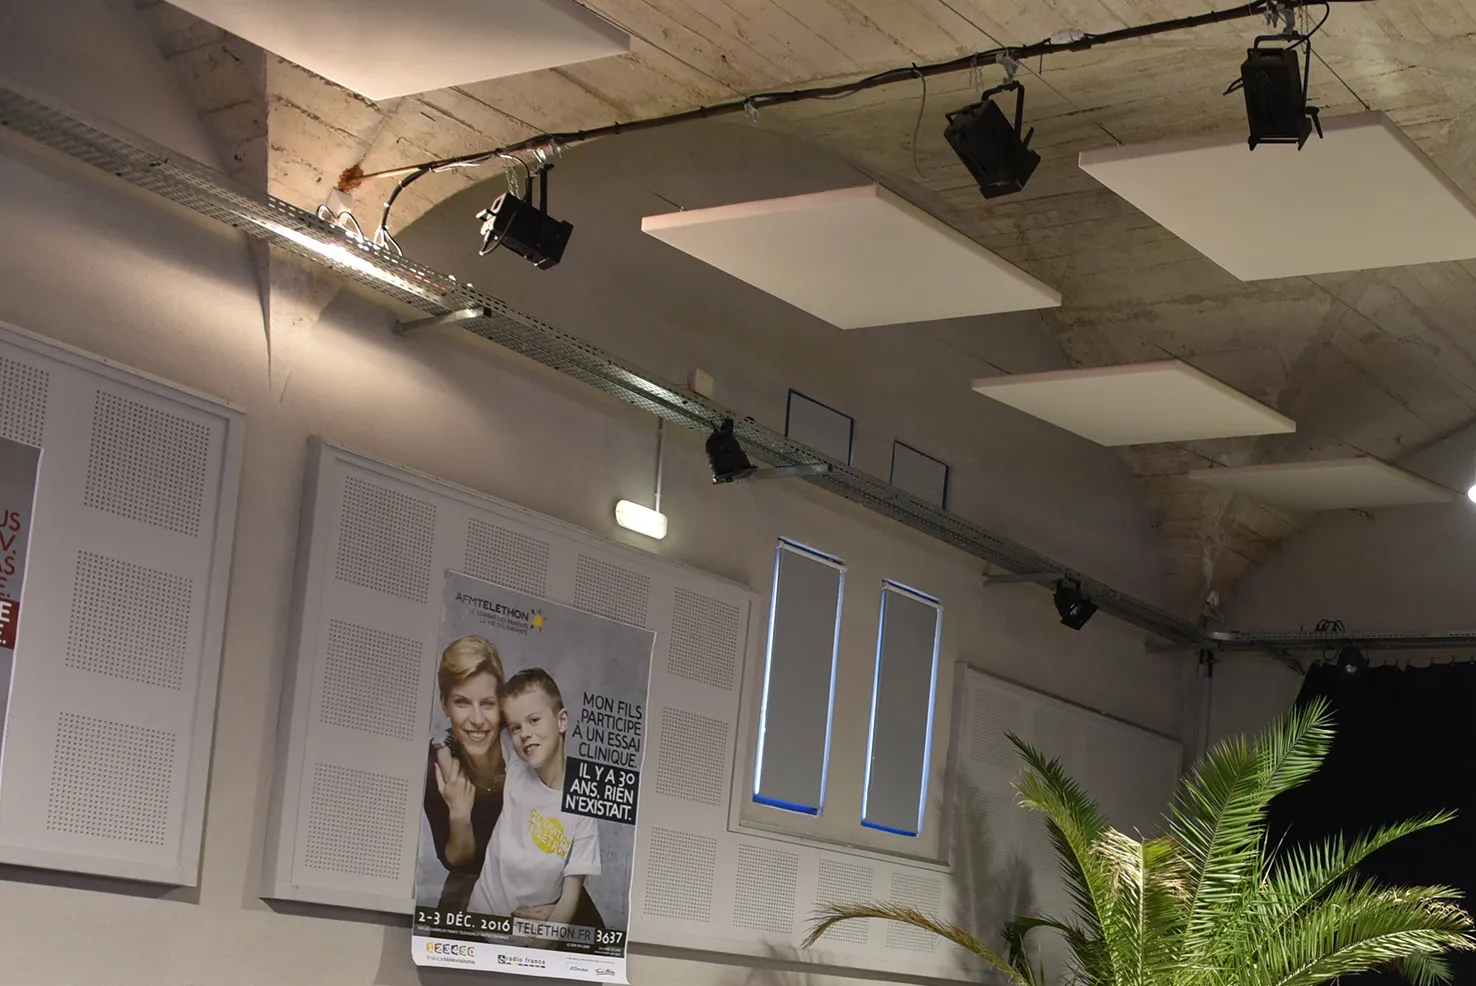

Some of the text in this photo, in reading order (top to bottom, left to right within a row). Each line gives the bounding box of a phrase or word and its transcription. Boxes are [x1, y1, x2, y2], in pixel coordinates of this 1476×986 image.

[583, 691, 643, 720] MON FILS
[581, 708, 642, 736] PARTICIPE
[572, 719, 641, 752] À UN ESSAI
[578, 741, 638, 769] CLINIQUE.
[579, 762, 636, 787] IL Y A 30
[604, 784, 634, 804] RIEN
[565, 794, 632, 821] N'EXISTAIT.
[418, 911, 511, 932] 2-3 DÉC. 2016
[516, 921, 591, 941] TELETHON.FR
[596, 929, 623, 944] 3637
